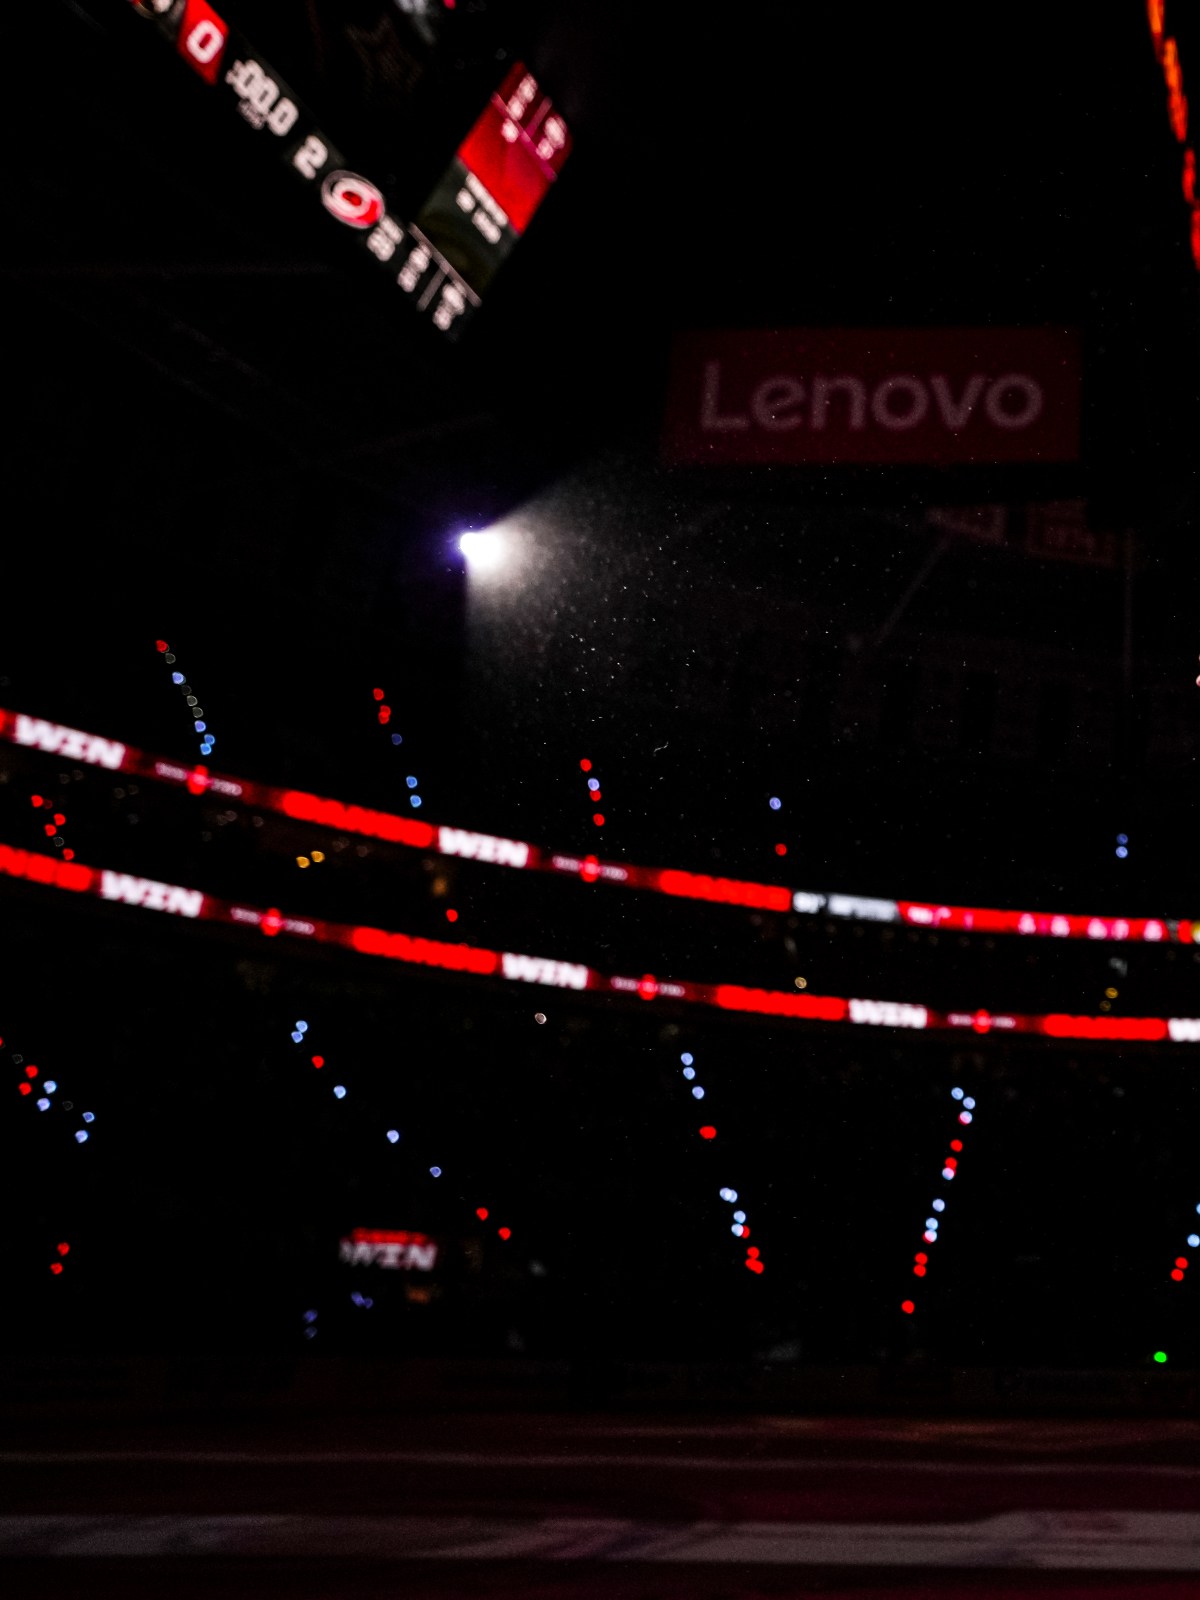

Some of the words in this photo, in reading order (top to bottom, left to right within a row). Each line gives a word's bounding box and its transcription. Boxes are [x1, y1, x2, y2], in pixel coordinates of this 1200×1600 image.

[186, 19, 224, 63] 0
[293, 135, 328, 180] 2
[701, 360, 1044, 431] Lenovo
[14, 714, 126, 770] WIN
[438, 826, 529, 868] WIN
[101, 870, 204, 918] WIN
[501, 952, 589, 990] WIN
[848, 998, 928, 1029] WIN
[339, 1241, 437, 1271] WIN
